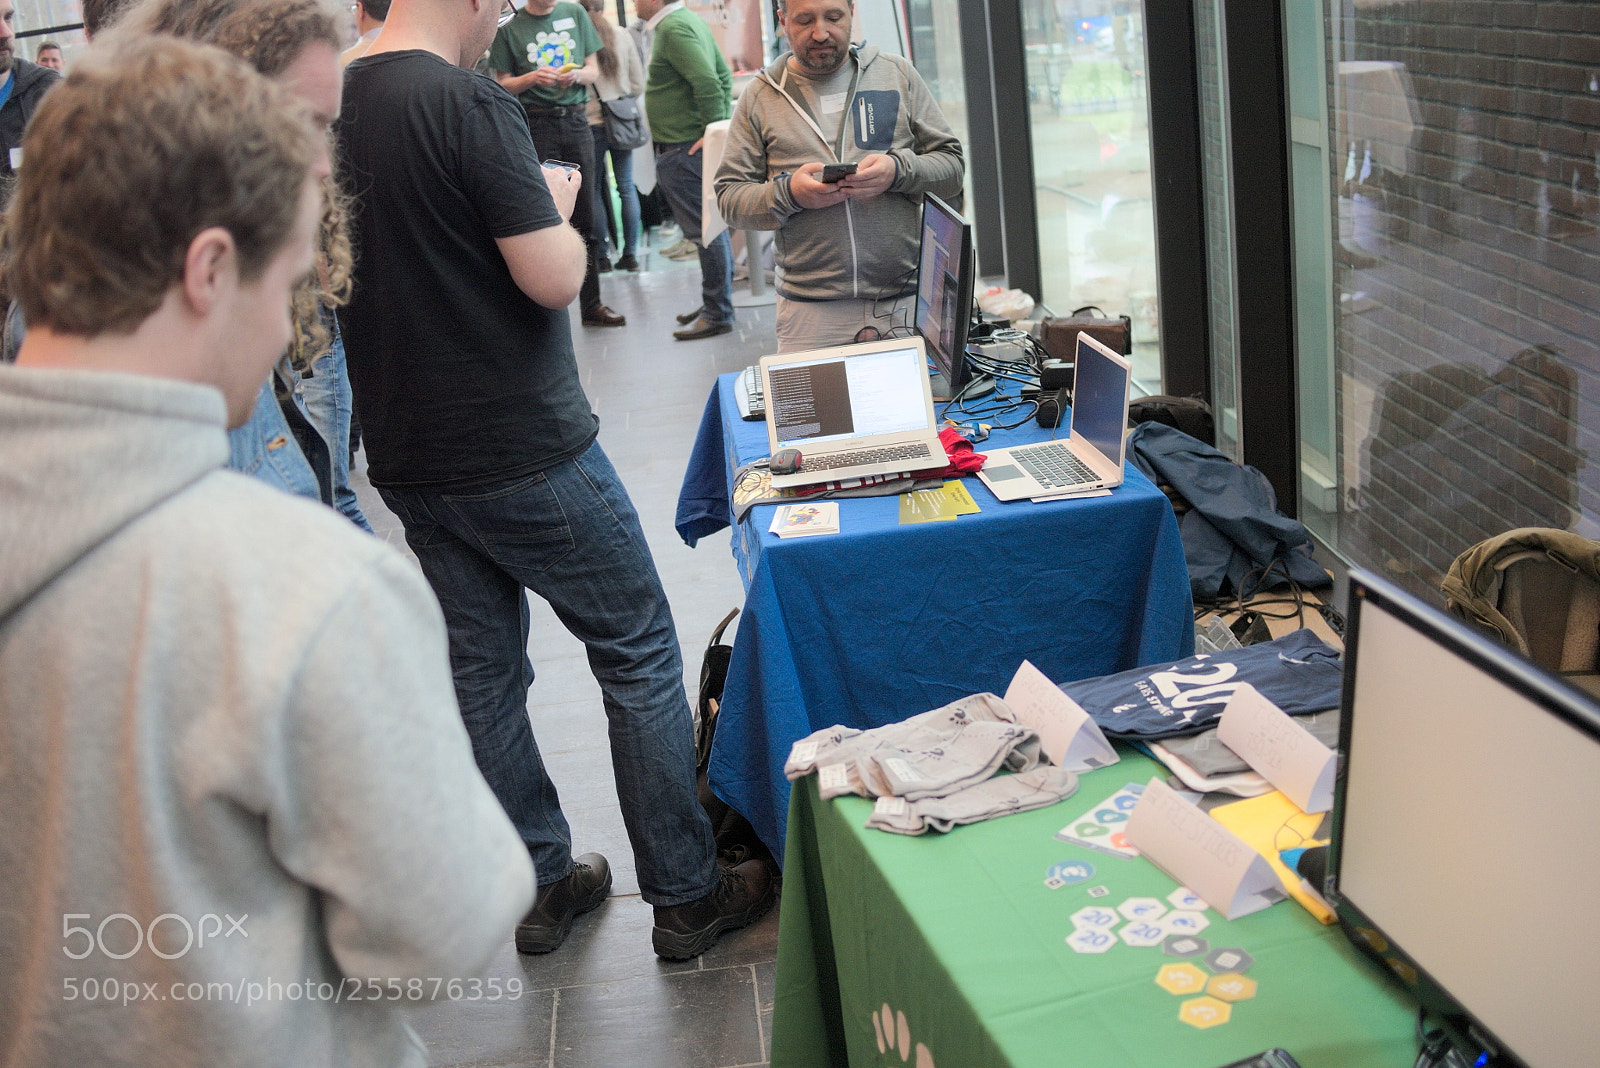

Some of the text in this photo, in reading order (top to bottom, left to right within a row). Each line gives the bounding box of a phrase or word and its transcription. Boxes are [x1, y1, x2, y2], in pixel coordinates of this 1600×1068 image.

[867, 103, 876, 135] ORTOVOX
[1081, 909, 1113, 926] 20
[1077, 929, 1110, 947] 20
[1128, 922, 1162, 940] 20
